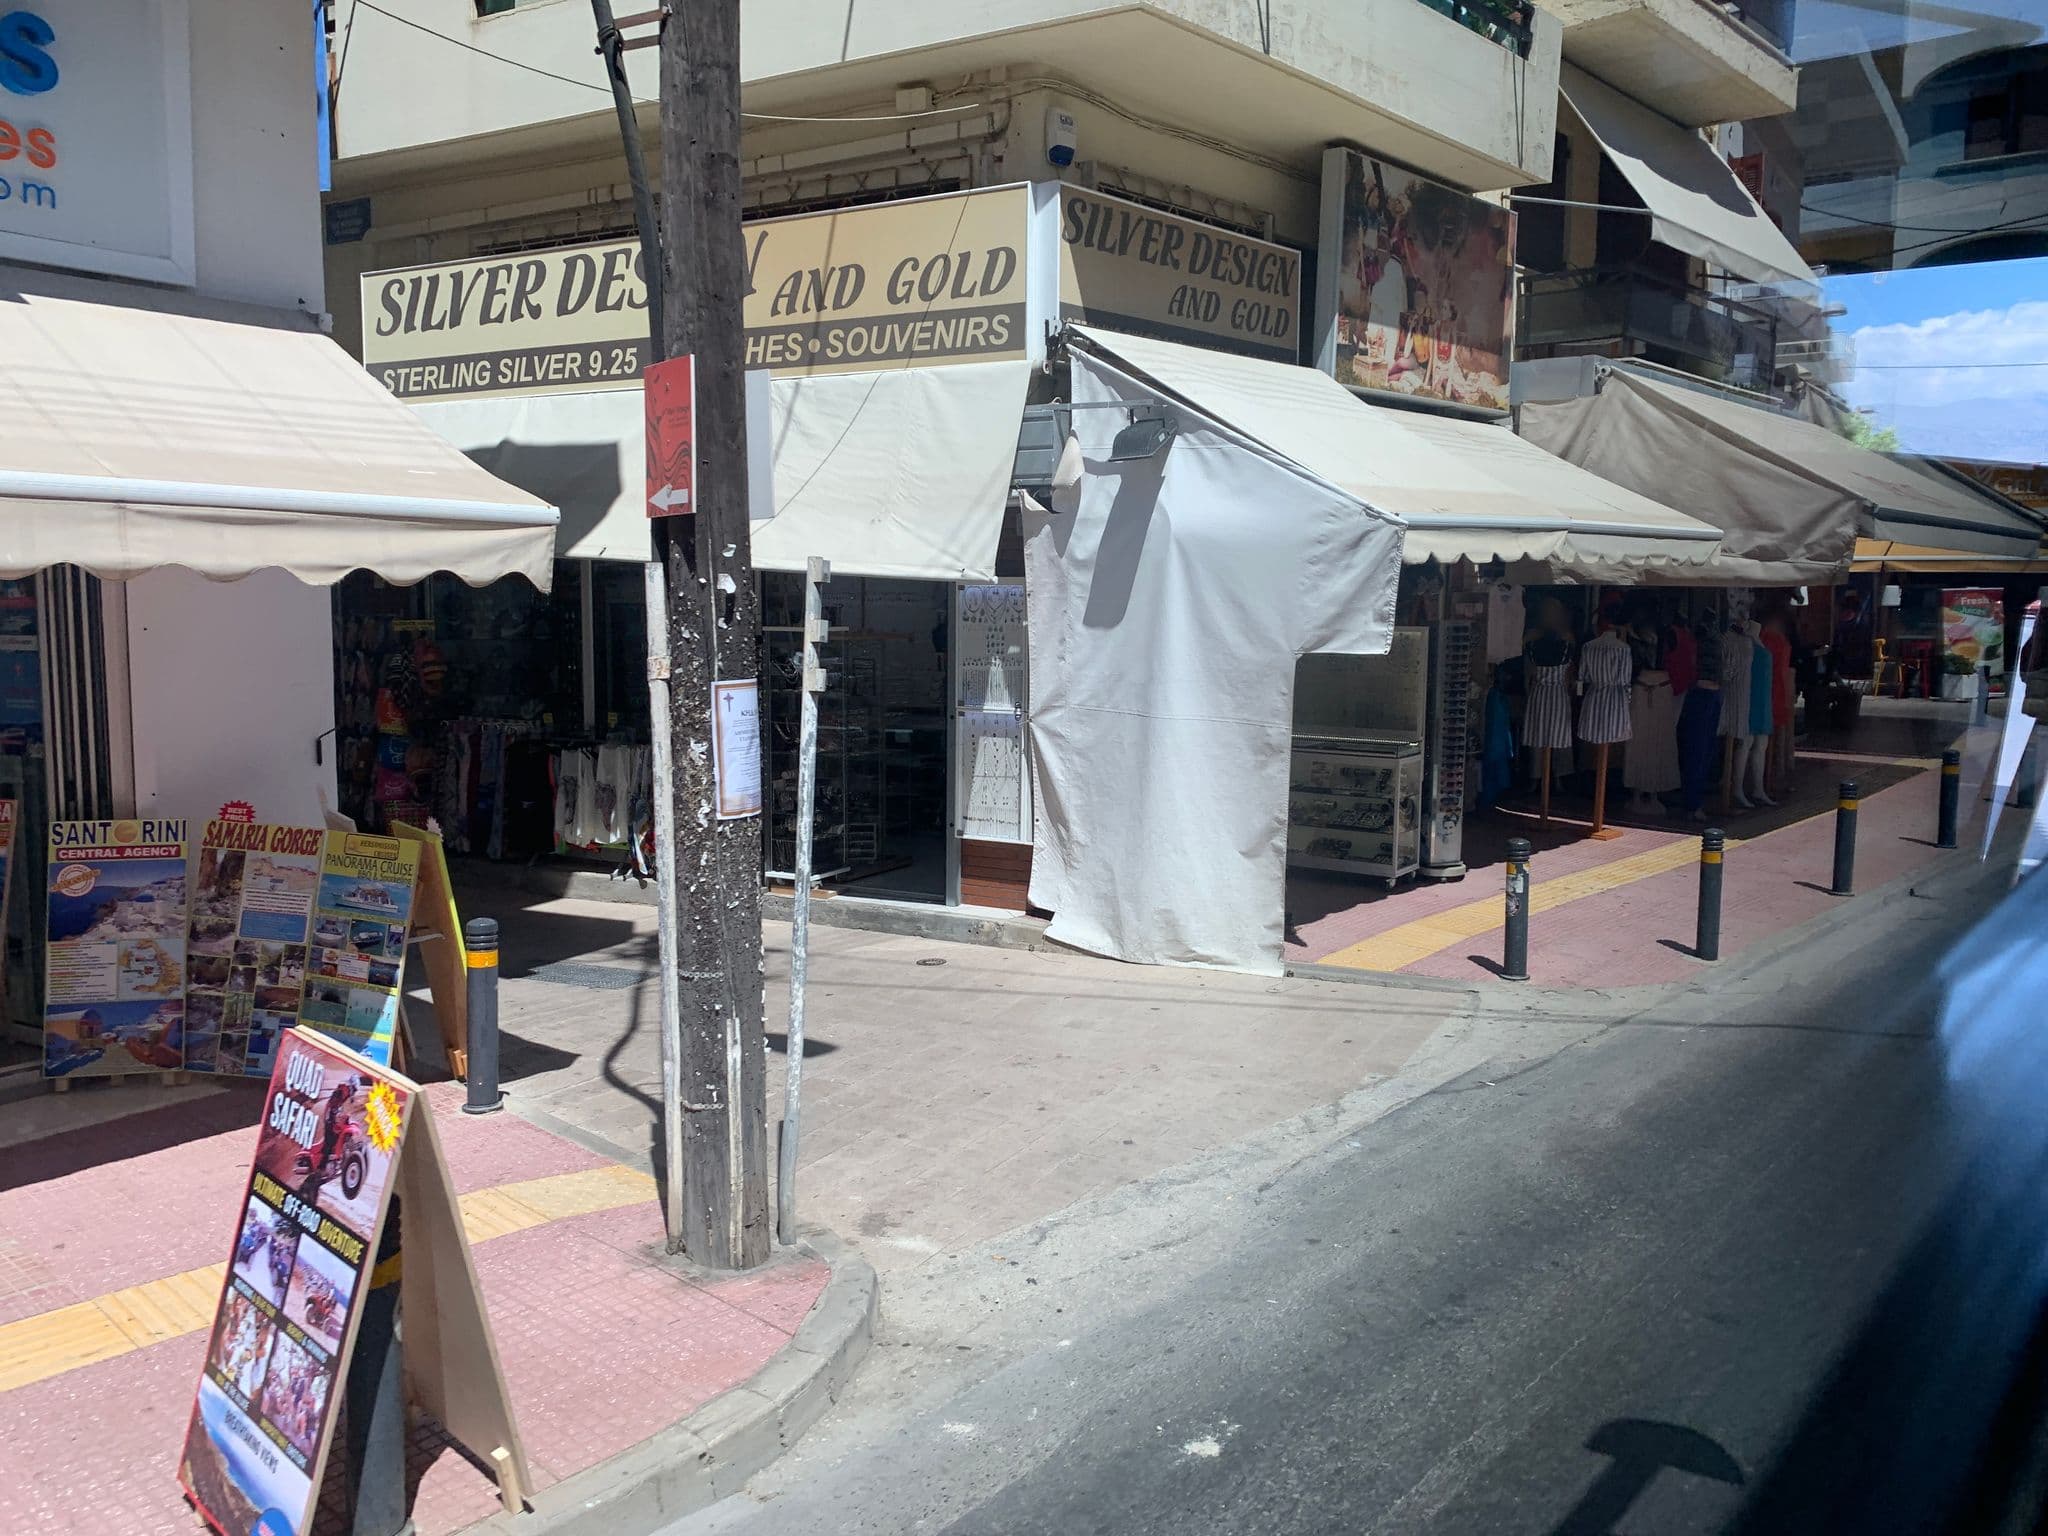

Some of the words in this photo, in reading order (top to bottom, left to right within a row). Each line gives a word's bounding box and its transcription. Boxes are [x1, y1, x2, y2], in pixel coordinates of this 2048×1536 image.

[1062, 197, 1184, 271] SILVER
[1188, 231, 1297, 297] DESIGN
[376, 259, 547, 336] SILVER
[771, 263, 865, 317] AND
[886, 246, 1017, 306] GOLD
[1168, 284, 1221, 323] AND
[1231, 298, 1290, 338] GOLD
[383, 360, 491, 393] STERLING
[498, 351, 582, 384] SILVER
[589, 347, 638, 377] 9.25
[826, 314, 1011, 358] SOUVENIRS
[59, 848, 120, 859] CENTRAL
[124, 846, 179, 857] AGENCY
[202, 820, 268, 852] SAMARIA
[271, 826, 323, 856] GORGE
[325, 853, 378, 871] PANORAMA
[380, 860, 414, 876] CRUISE
[285, 1050, 325, 1100] QUAD
[270, 1092, 319, 1149] SAFARI
[283, 1194, 321, 1233] OFF-ROAD
[317, 1219, 364, 1264] ADVENTURE
